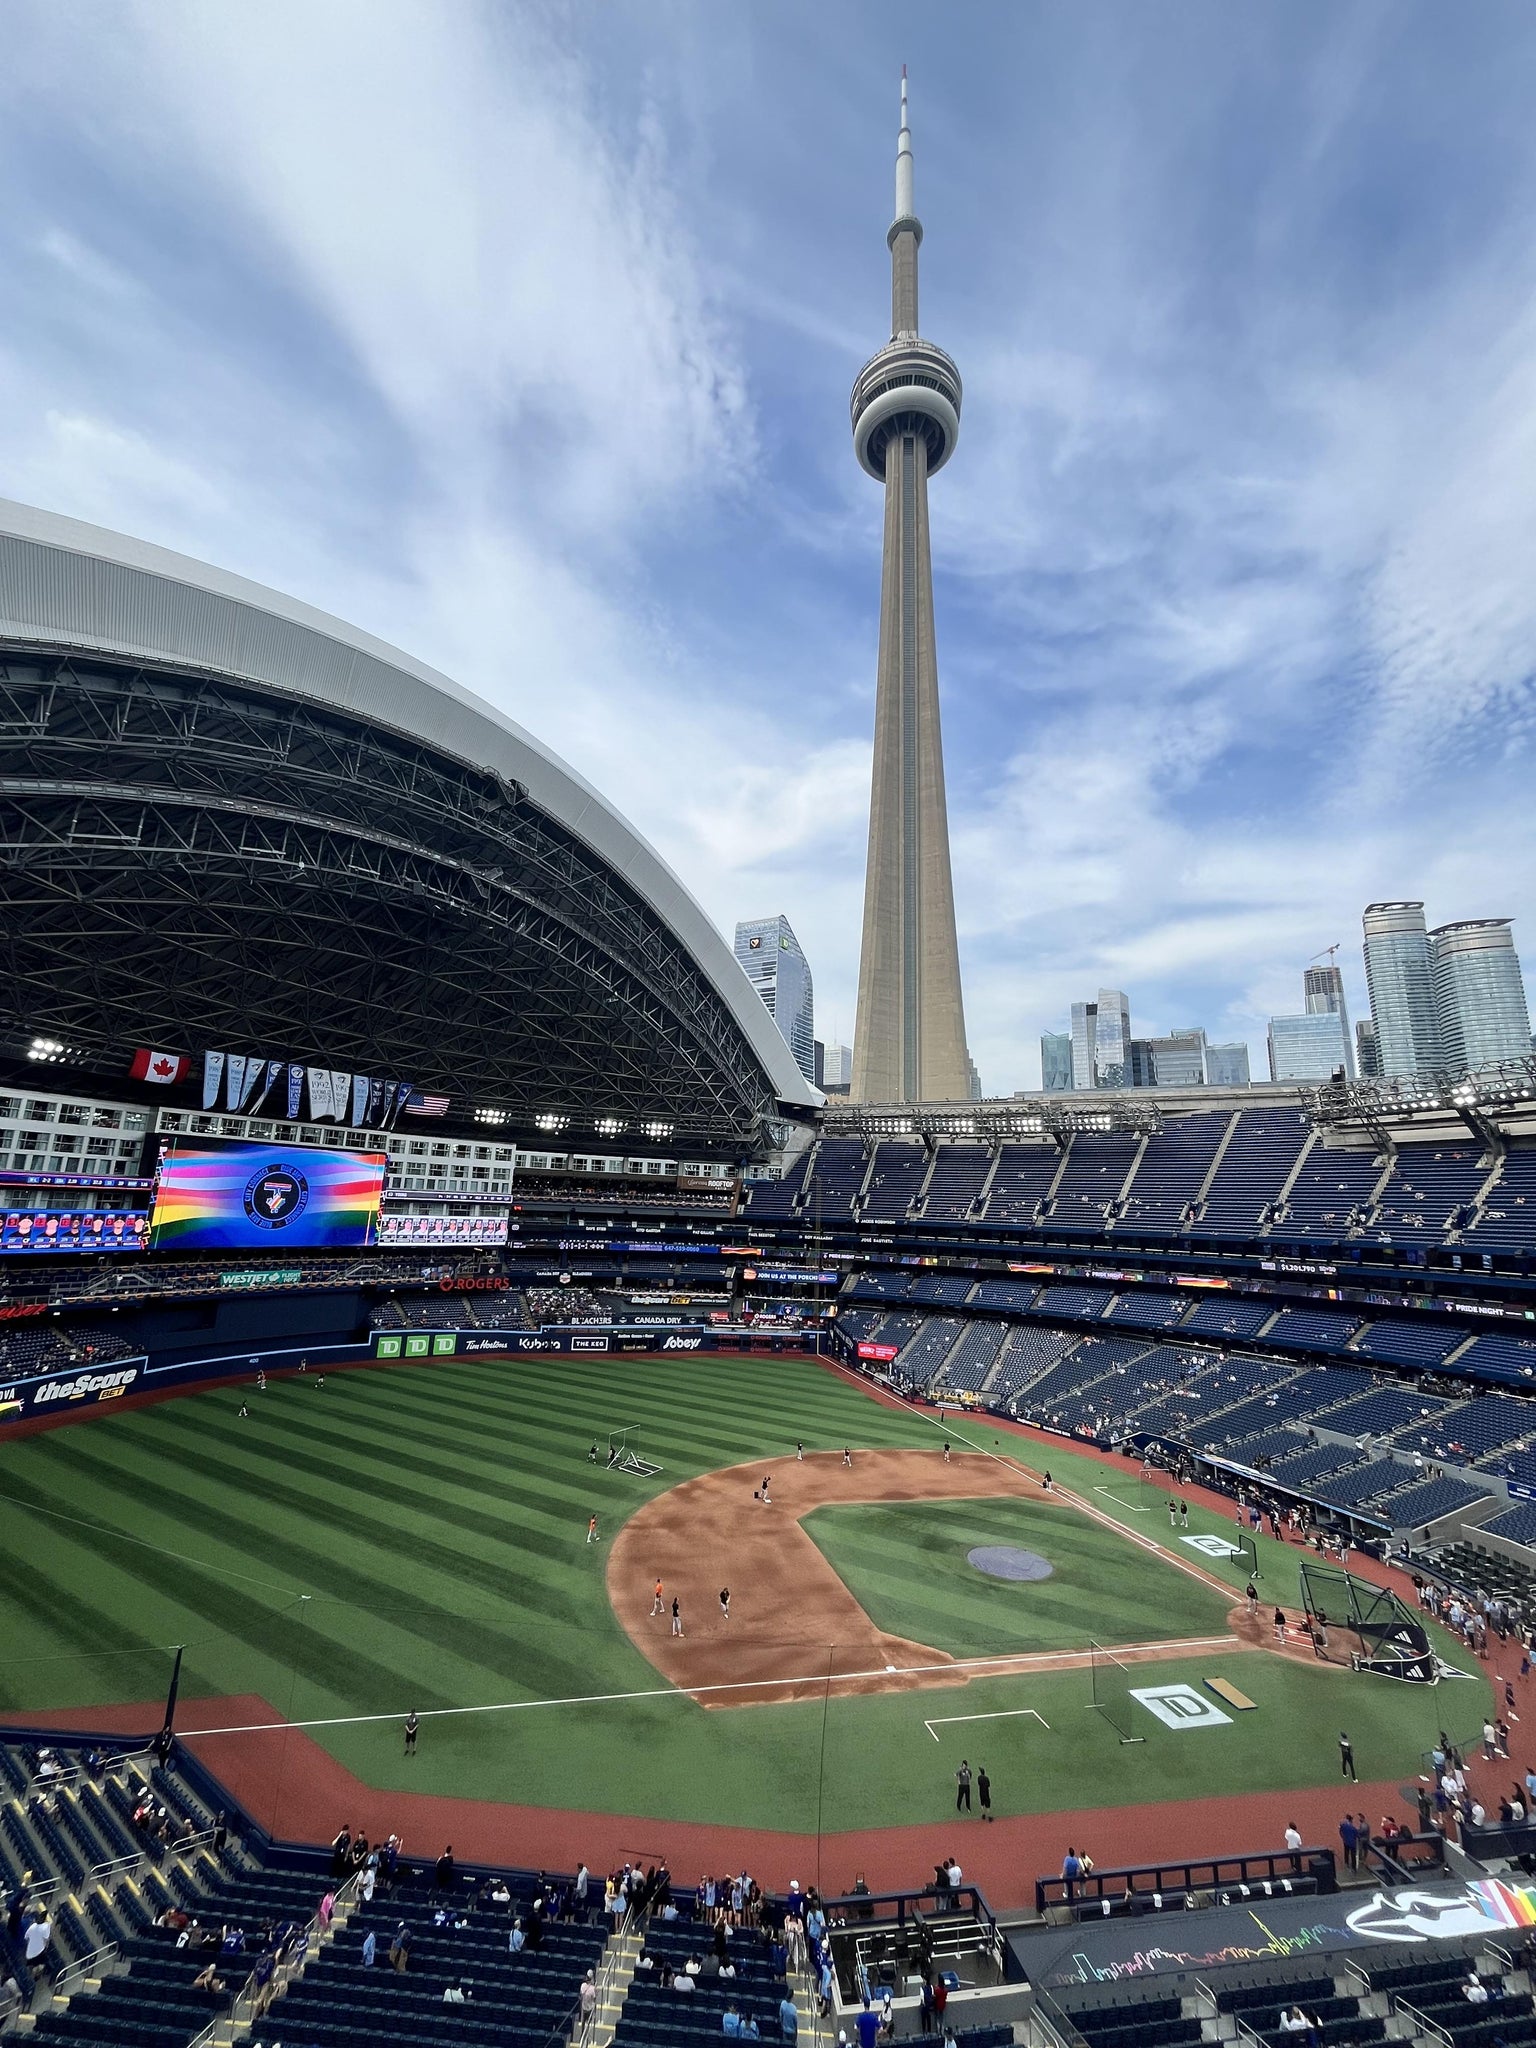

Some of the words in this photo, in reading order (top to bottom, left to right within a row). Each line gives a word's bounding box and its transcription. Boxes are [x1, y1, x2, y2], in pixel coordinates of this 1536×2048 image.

[311, 1080, 329, 1090] 1992
[708, 1180, 734, 1188] ROOFTOP
[222, 1273, 269, 1285] WESTJET
[457, 1277, 510, 1289] ROGERS
[1455, 1304, 1478, 1313] PRIDE
[1478, 1307, 1504, 1316] NIGHT
[634, 1316, 666, 1324] CANADA
[381, 1340, 399, 1354] TD
[408, 1339, 427, 1353] TD
[436, 1338, 454, 1352] TD
[466, 1340, 480, 1351] Tim
[480, 1339, 508, 1350] Hortons
[519, 1338, 561, 1349] Kuboa
[663, 1335, 702, 1350] Sobeys
[34, 1368, 138, 1403] theScore
[101, 1387, 123, 1399] BET
[1144, 1694, 1210, 1718] TD
